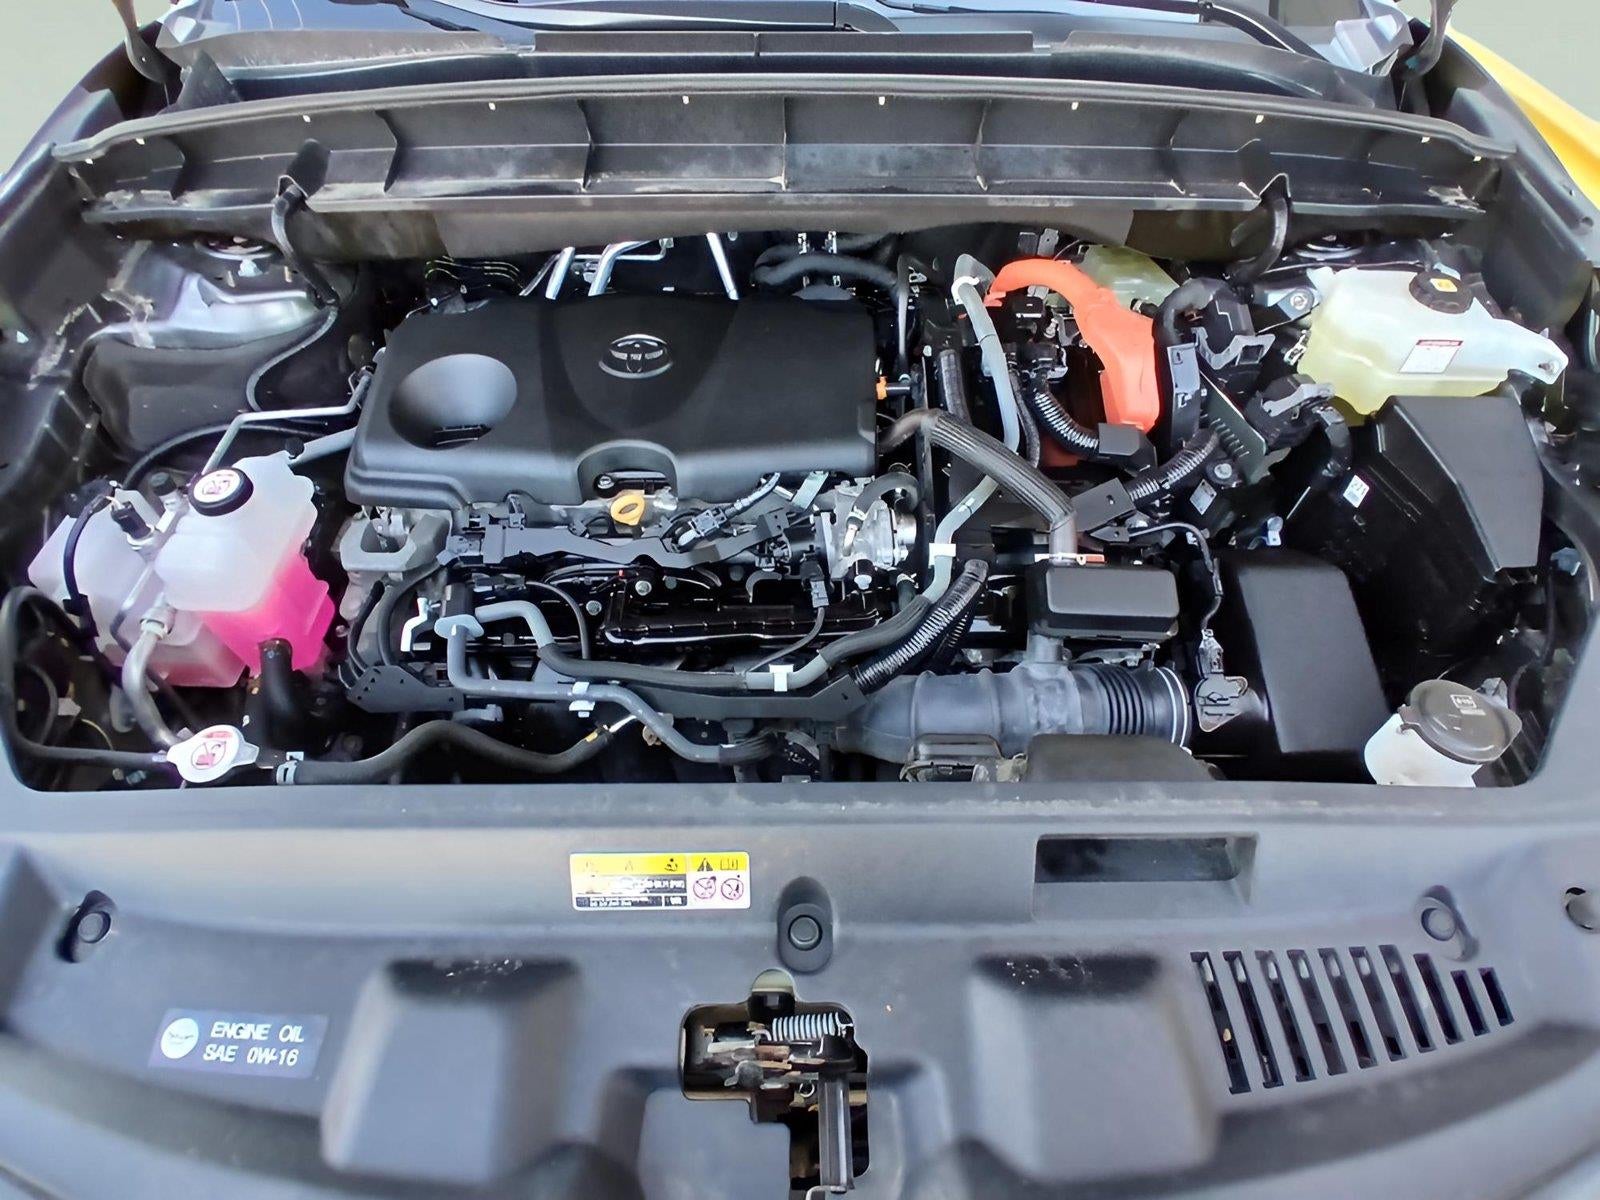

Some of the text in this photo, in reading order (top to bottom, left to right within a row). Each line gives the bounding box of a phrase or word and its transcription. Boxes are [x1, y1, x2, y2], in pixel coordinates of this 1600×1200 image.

[211, 1022, 304, 1043] ENGINE OIL
[203, 1044, 299, 1067] SAE 0W-16
